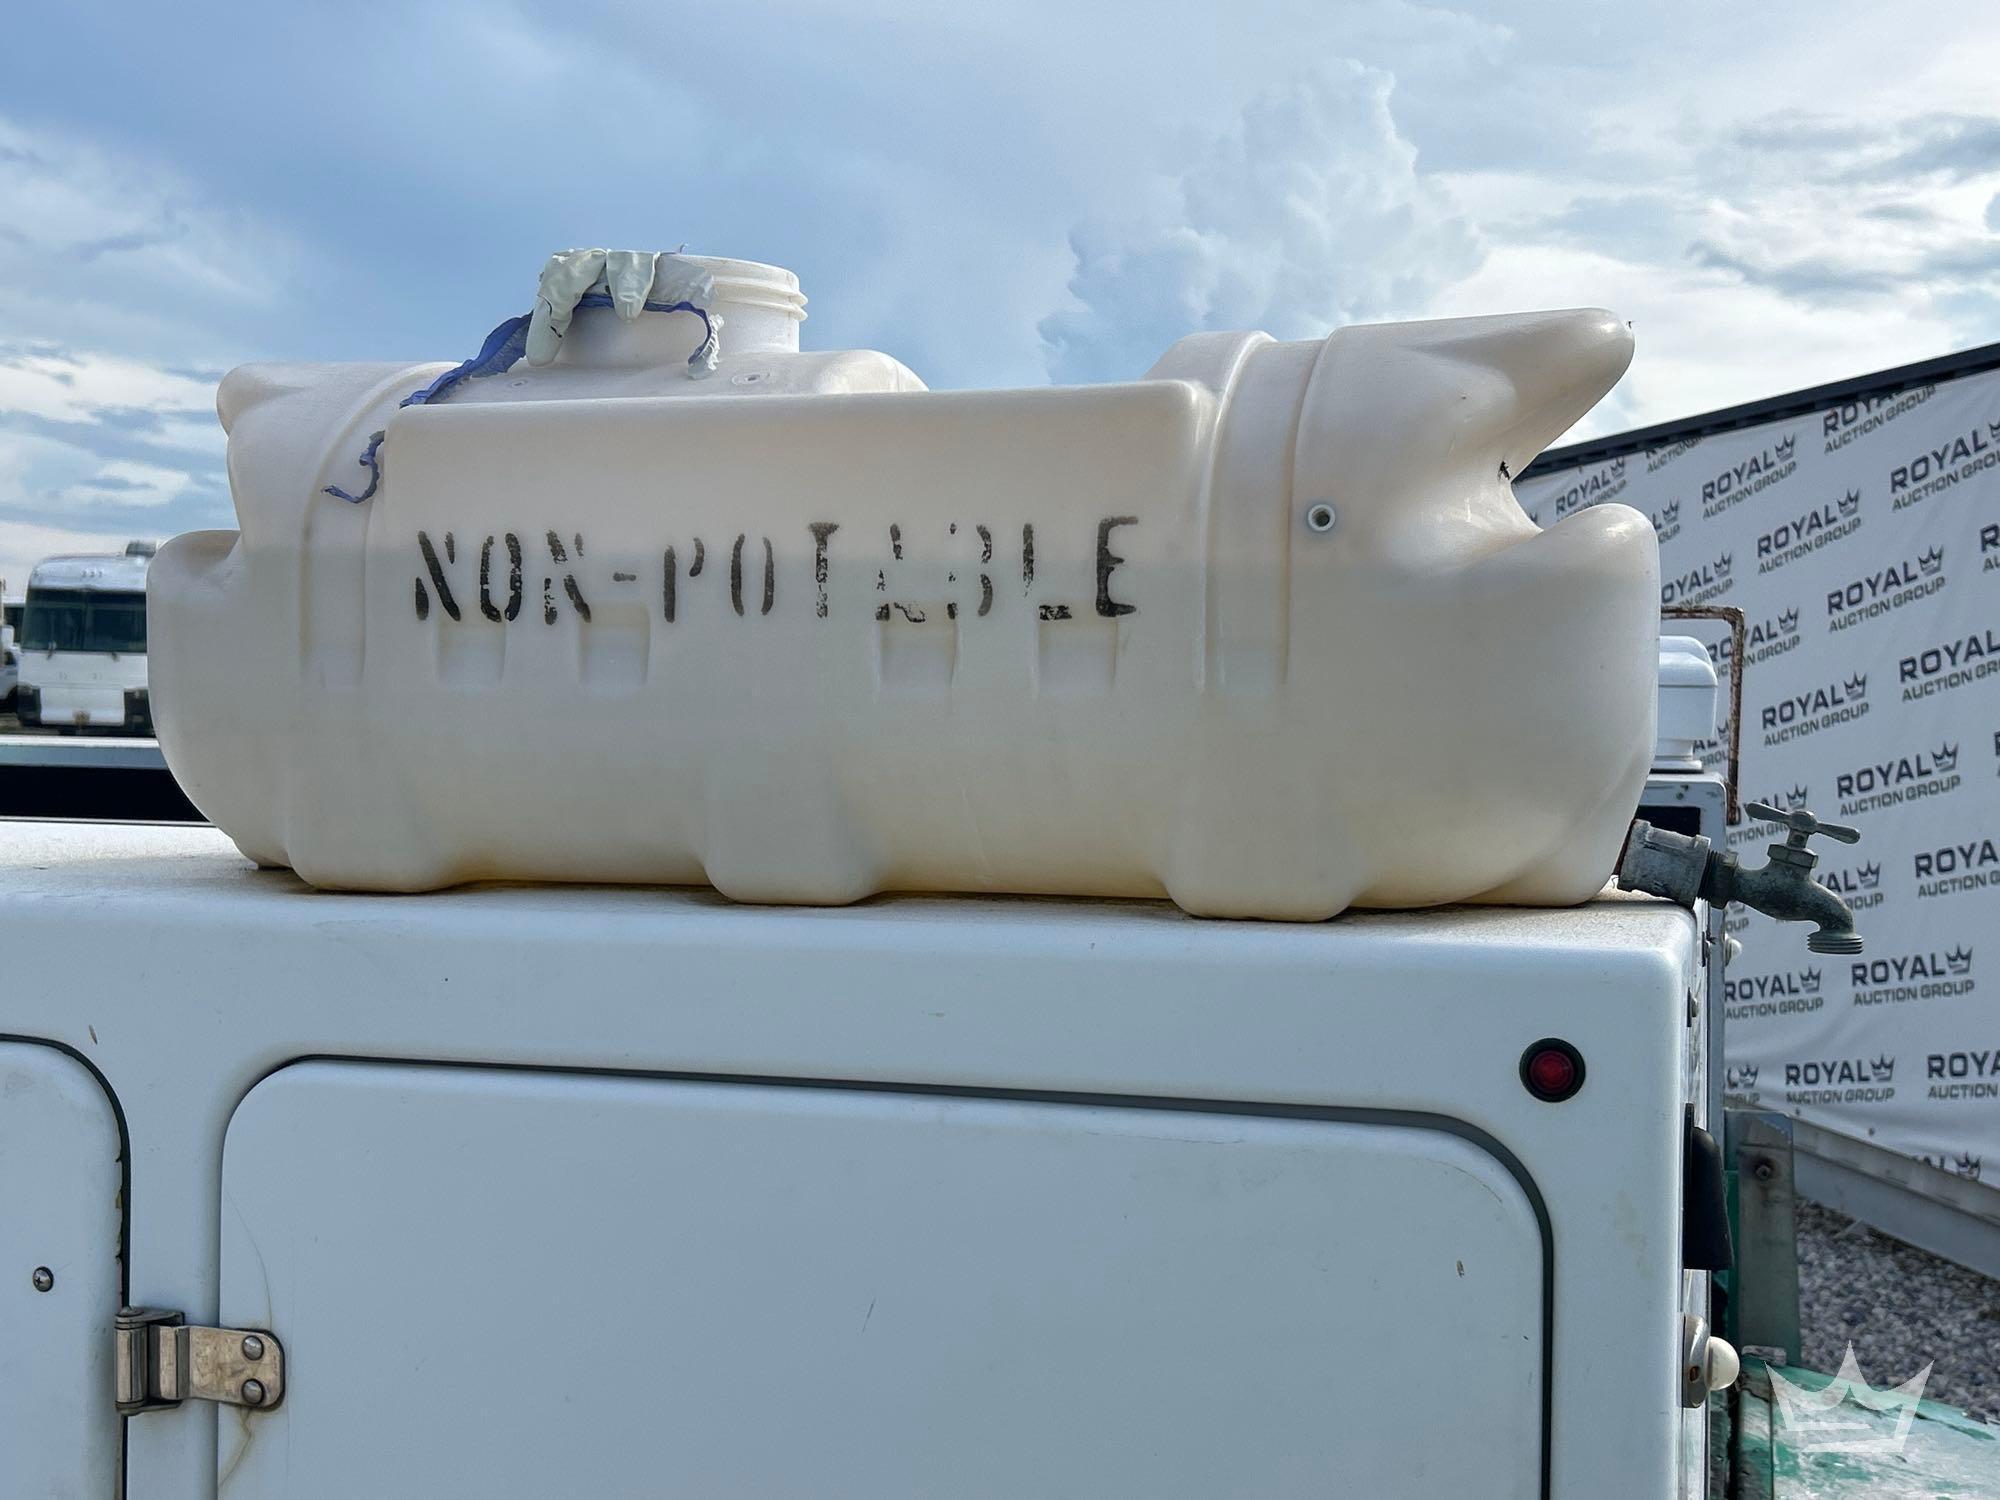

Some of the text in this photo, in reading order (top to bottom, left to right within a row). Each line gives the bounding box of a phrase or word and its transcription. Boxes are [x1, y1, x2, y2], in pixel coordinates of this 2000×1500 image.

[1824, 384, 1936, 454] AUCTION GROUP
[1702, 450, 1774, 503] ROYAL
[1891, 429, 1988, 494] ROYAL
[1556, 470, 1610, 515] ROYAL
[1703, 461, 1796, 520] AUCTION GROUP
[1892, 470, 1960, 511] AUCTION
[1757, 504, 1838, 558] ROYAL
[1759, 517, 1861, 575] AUCTION GROUP
[1661, 566, 1713, 603] OYAL
[1695, 578, 1733, 604] GROUP
[1828, 562, 1918, 614] ROYAL
[1829, 576, 1945, 634] AUCTION GROUP
[1757, 635, 1800, 662] GROUP
[1900, 630, 2000, 682] ROYAL
[1902, 668, 1973, 702] AUCTION
[1762, 684, 1844, 730] ROYAL
[1764, 702, 1869, 747] AUCTION GROUP
[1836, 753, 1932, 798] ROYAL
[1840, 775, 1961, 817] AUCTION GROUP
[1918, 874, 1987, 898] AUCTION
[1724, 973, 1800, 1002] ROYAL
[1851, 953, 1946, 987] ROYAL
[1726, 997, 1824, 1018] AUCTION GROUP
[1854, 980, 1975, 1006] AUCTION GROUP
[1785, 1059, 1871, 1085] ROYAL
[1928, 1083, 1998, 1099] AUCTION
[1785, 1087, 1896, 1104] AUCTION GROUP
